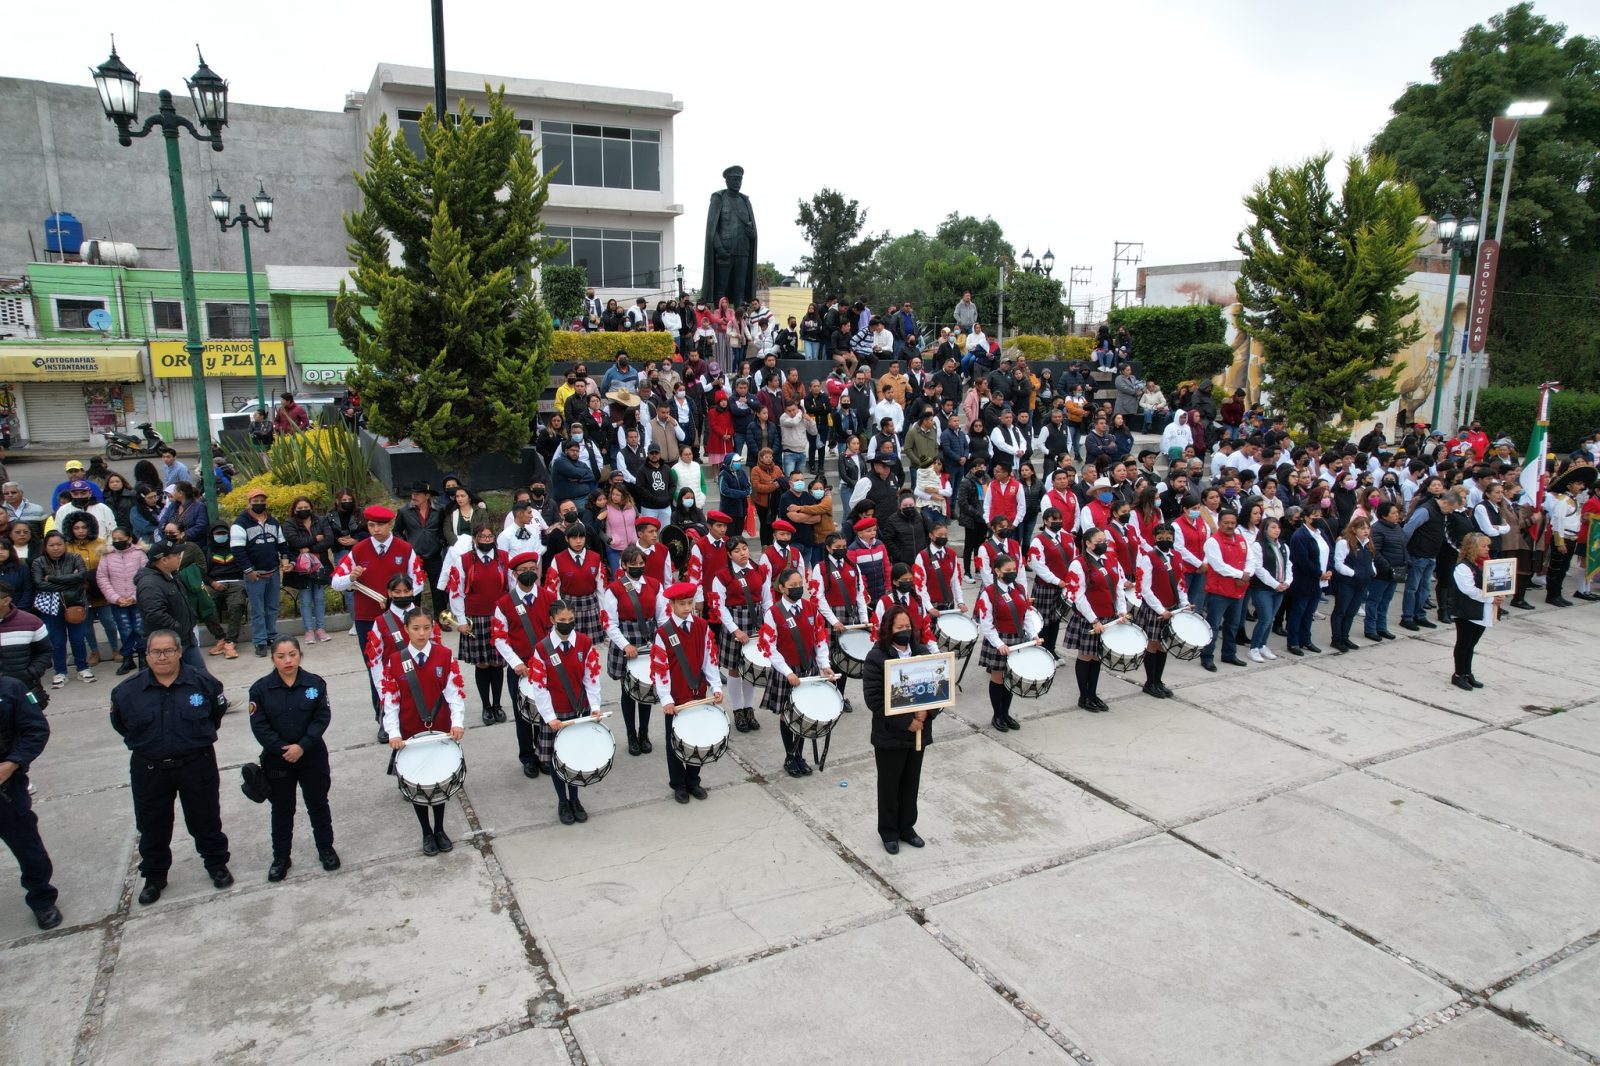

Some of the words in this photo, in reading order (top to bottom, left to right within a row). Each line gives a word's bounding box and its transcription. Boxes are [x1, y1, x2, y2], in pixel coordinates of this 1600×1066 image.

[1474, 252, 1492, 342] TEOLOYUCAN
[183, 344, 254, 353] CPRAMOS
[206, 357, 216, 369] y
